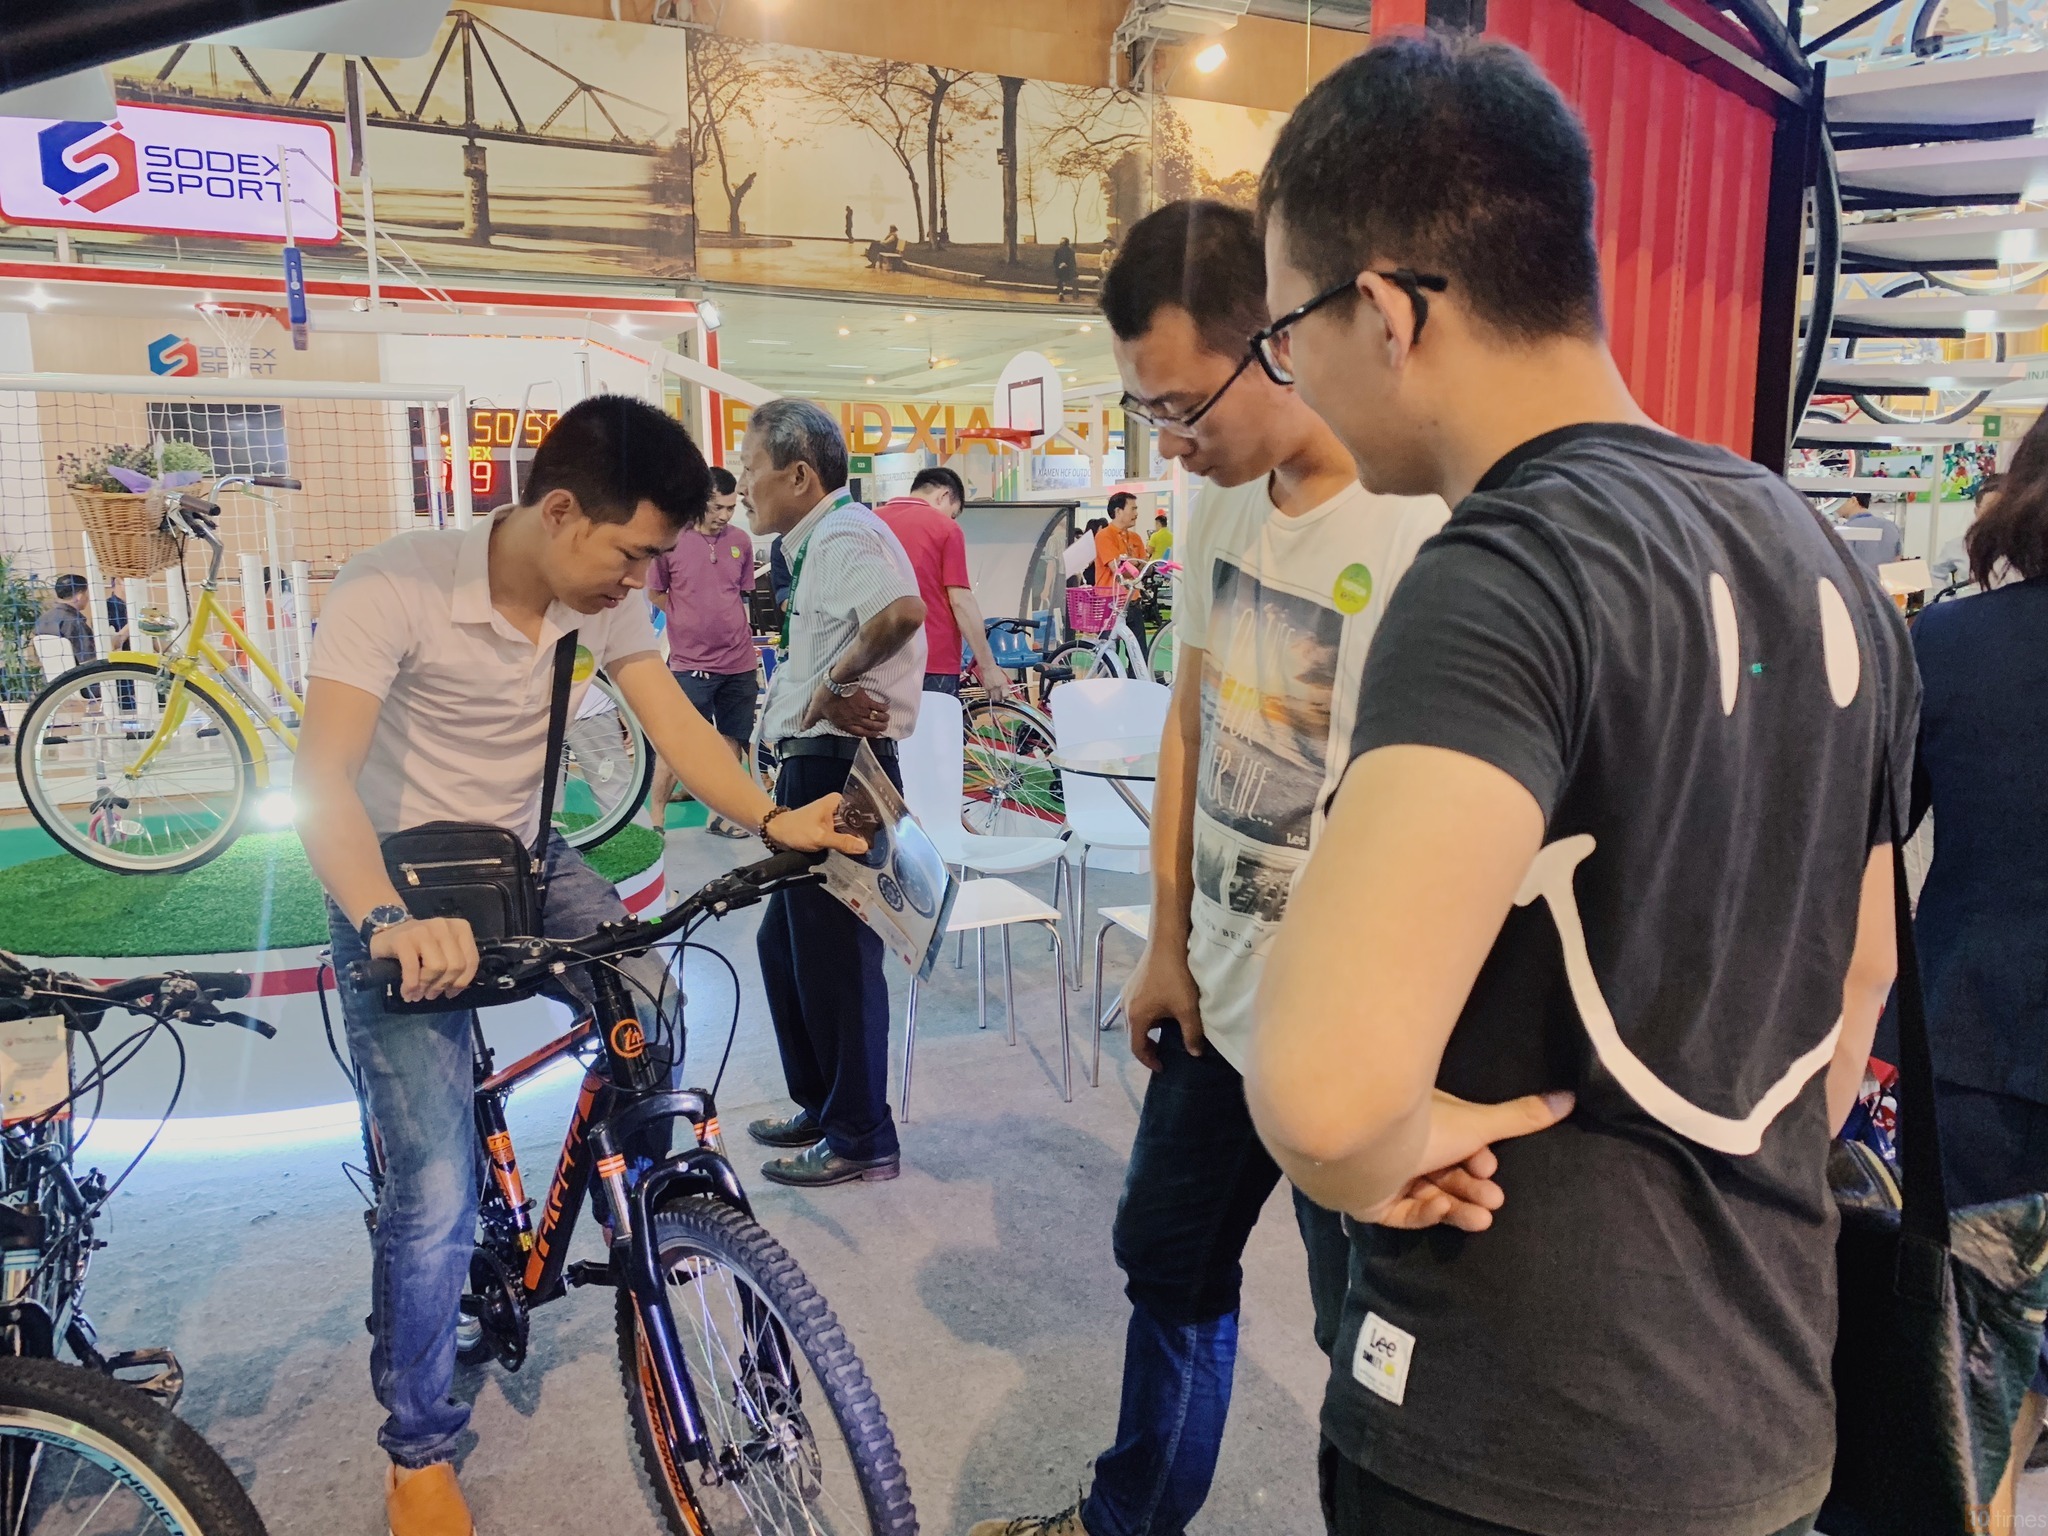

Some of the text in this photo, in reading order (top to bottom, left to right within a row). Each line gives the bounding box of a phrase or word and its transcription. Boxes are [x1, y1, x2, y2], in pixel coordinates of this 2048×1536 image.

[144, 145, 288, 176] SODEX
[147, 172, 290, 203] SPORT
[200, 346, 276, 360] SOEX
[201, 361, 277, 375] SPRT
[1286, 832, 1307, 847] Lee
[1370, 1328, 1397, 1358] Lee
[110, 1463, 176, 1527] THONG
